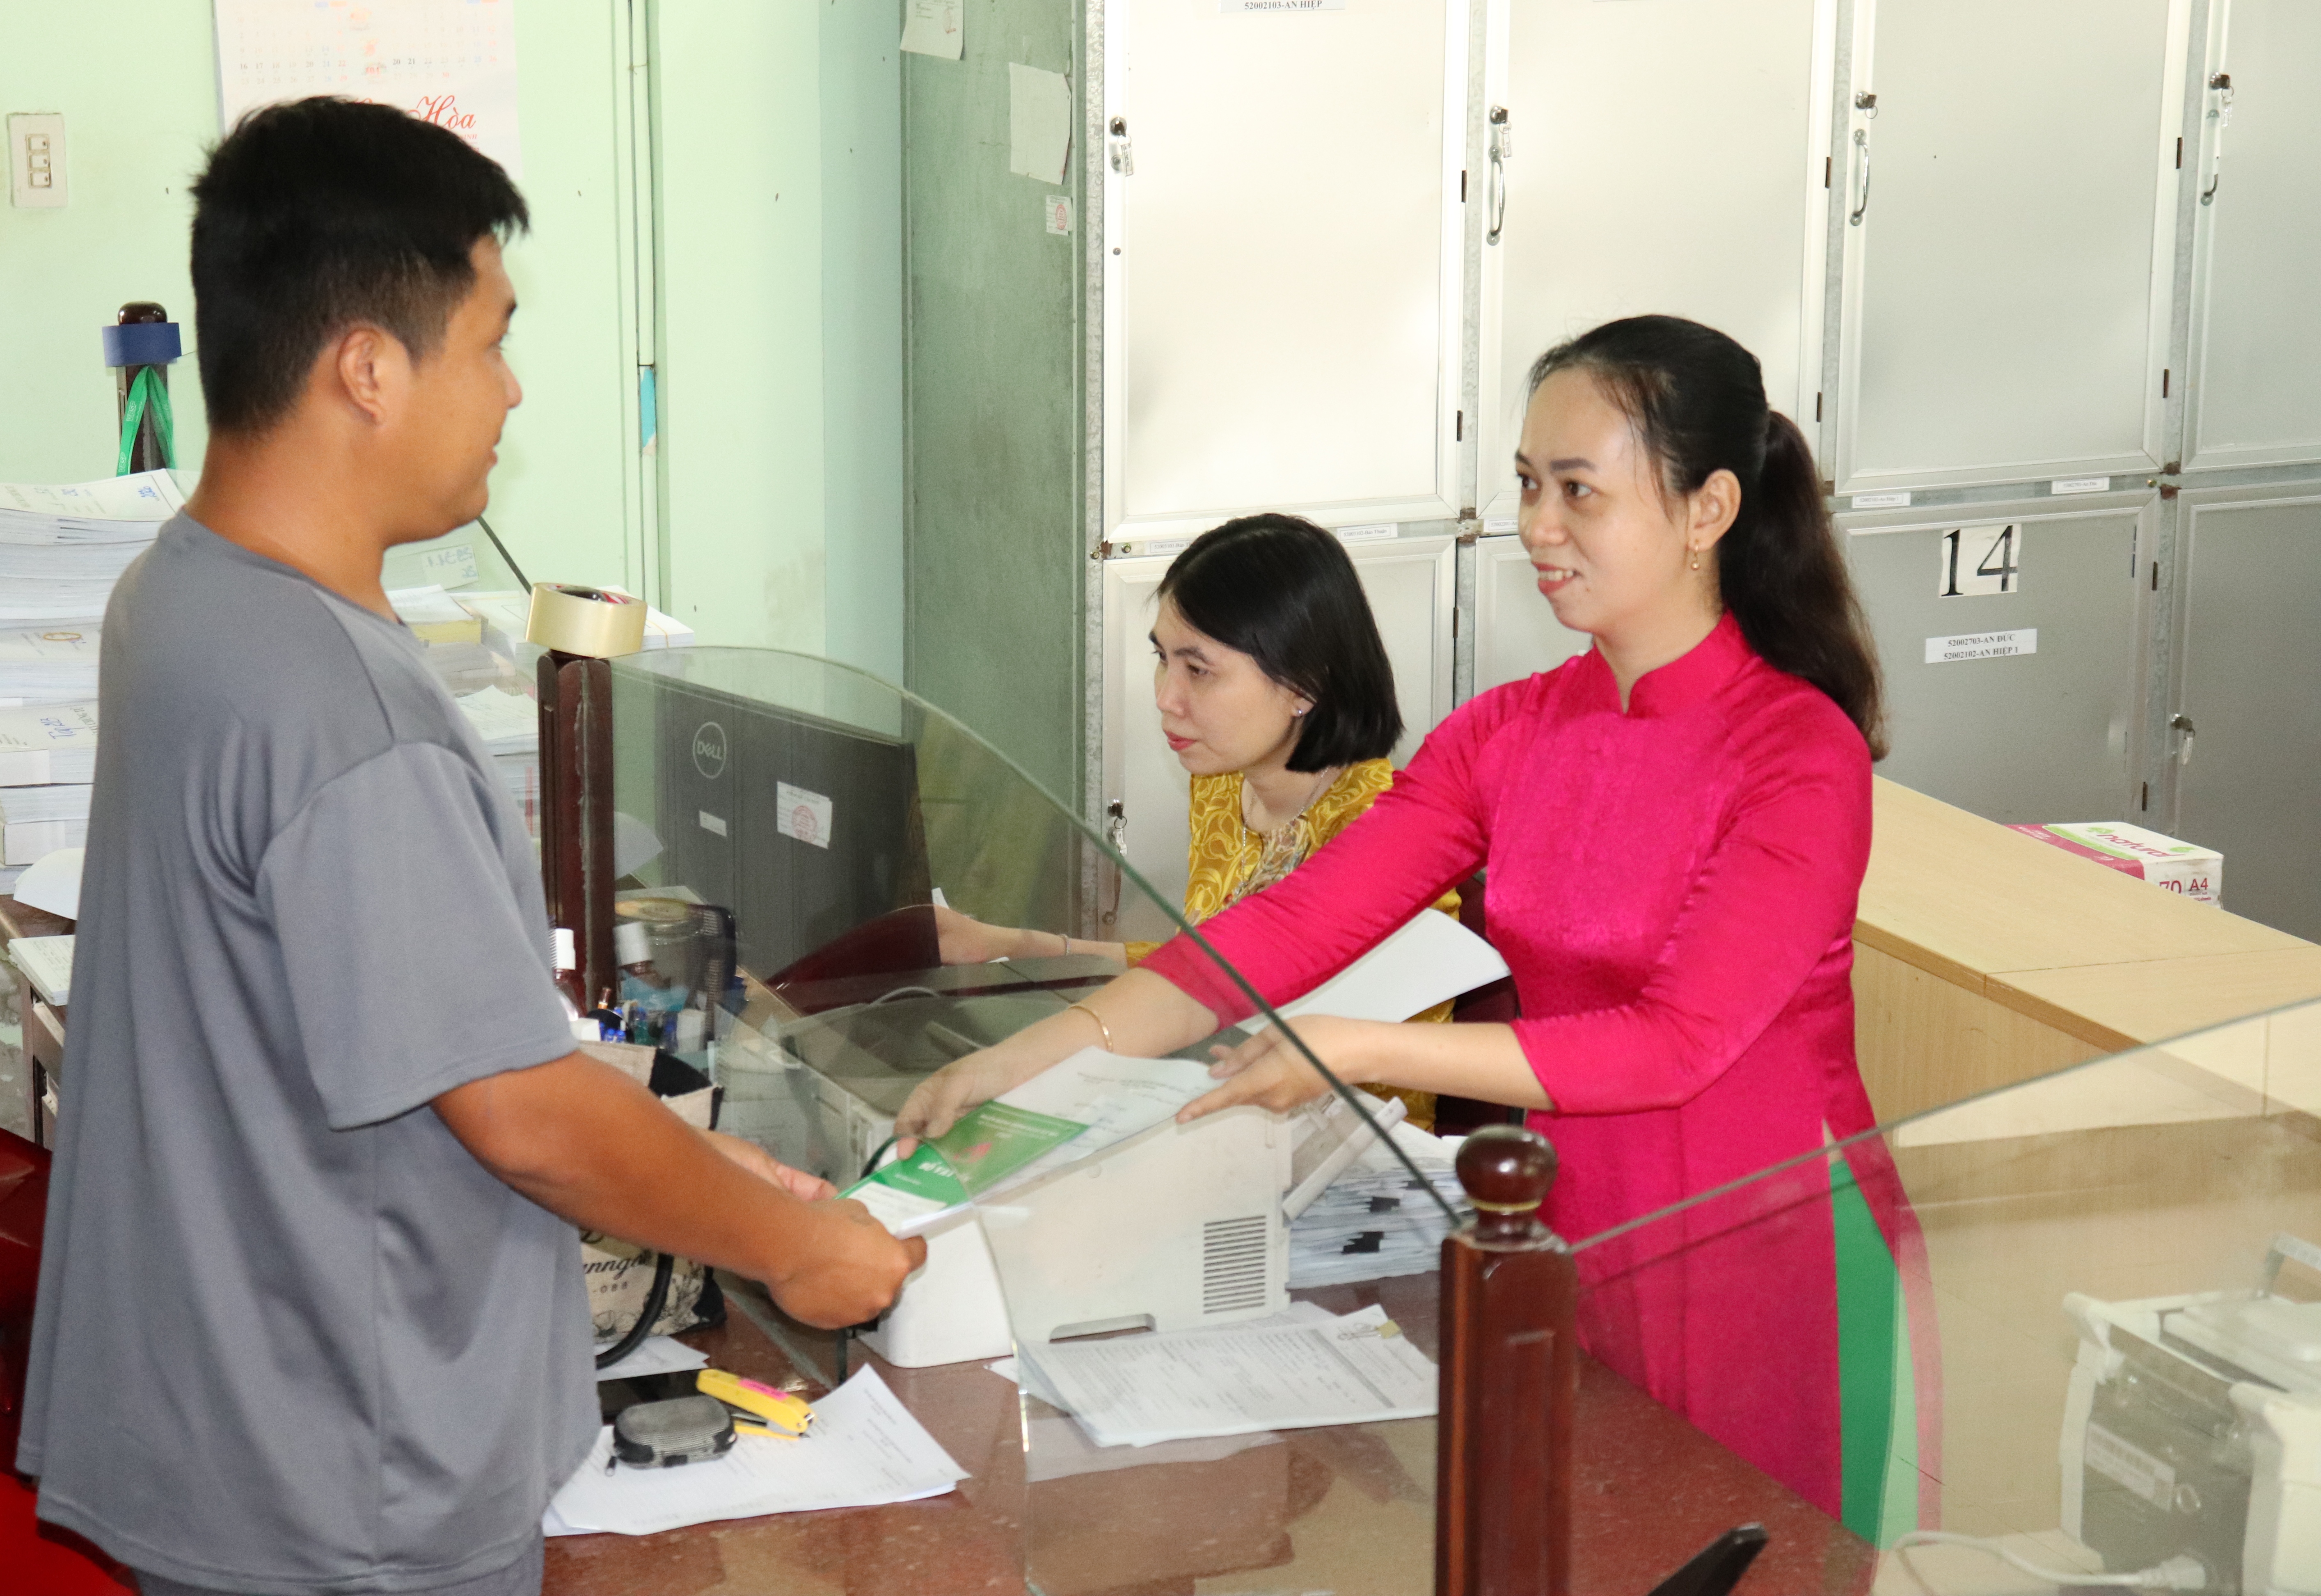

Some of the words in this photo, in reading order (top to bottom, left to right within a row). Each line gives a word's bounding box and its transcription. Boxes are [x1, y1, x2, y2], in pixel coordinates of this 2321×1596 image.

[1244, 1, 1297, 9] 52002103-AN
[1941, 524, 2018, 597] 14
[1948, 634, 1995, 647] 52002703-AN
[1943, 648, 1991, 660] 52002102-AN
[1993, 646, 2012, 657] HIỆP
[697, 740, 722, 760] DELL
[2097, 833, 2186, 857] natural
[2188, 877, 2209, 891] A4
